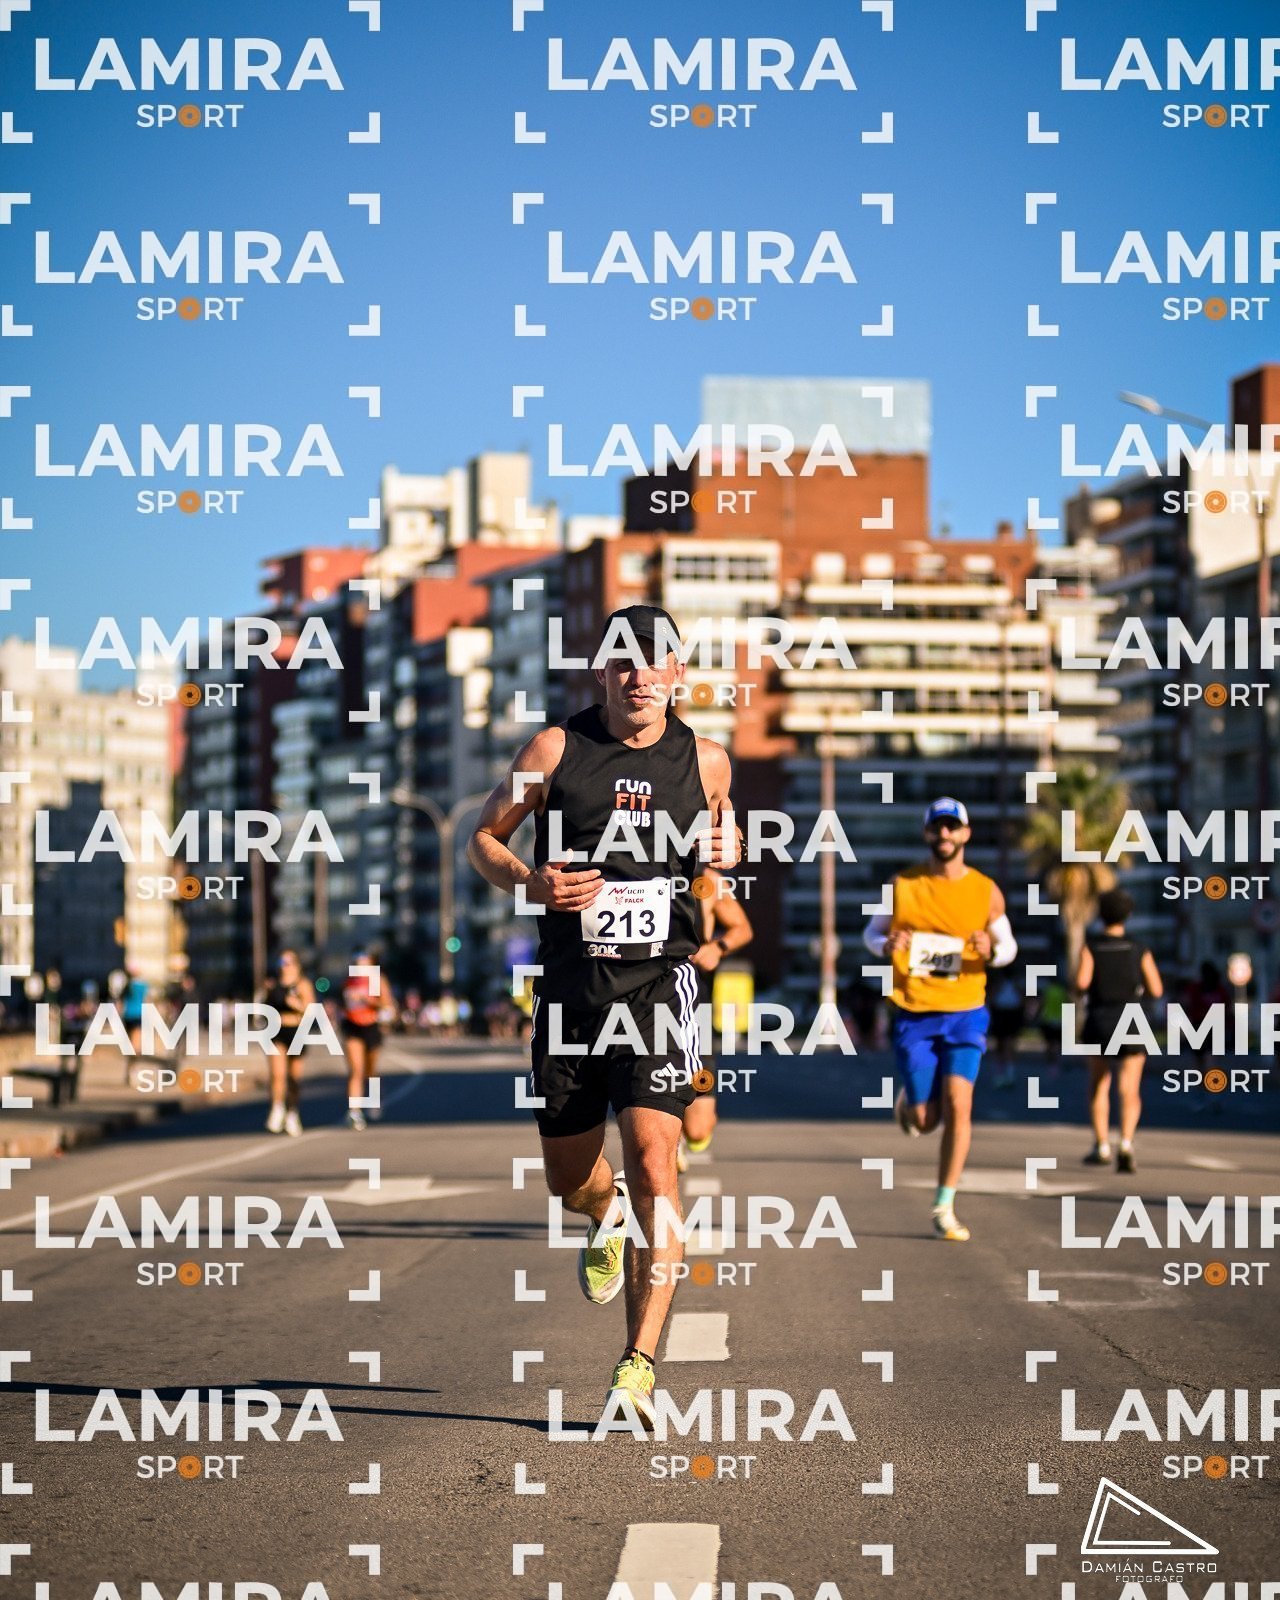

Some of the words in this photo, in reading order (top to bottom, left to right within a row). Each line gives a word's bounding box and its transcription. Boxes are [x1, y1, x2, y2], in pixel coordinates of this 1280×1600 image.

[616, 793, 651, 811] FIT
[614, 810, 651, 827] CLUB
[597, 910, 656, 938] 213
